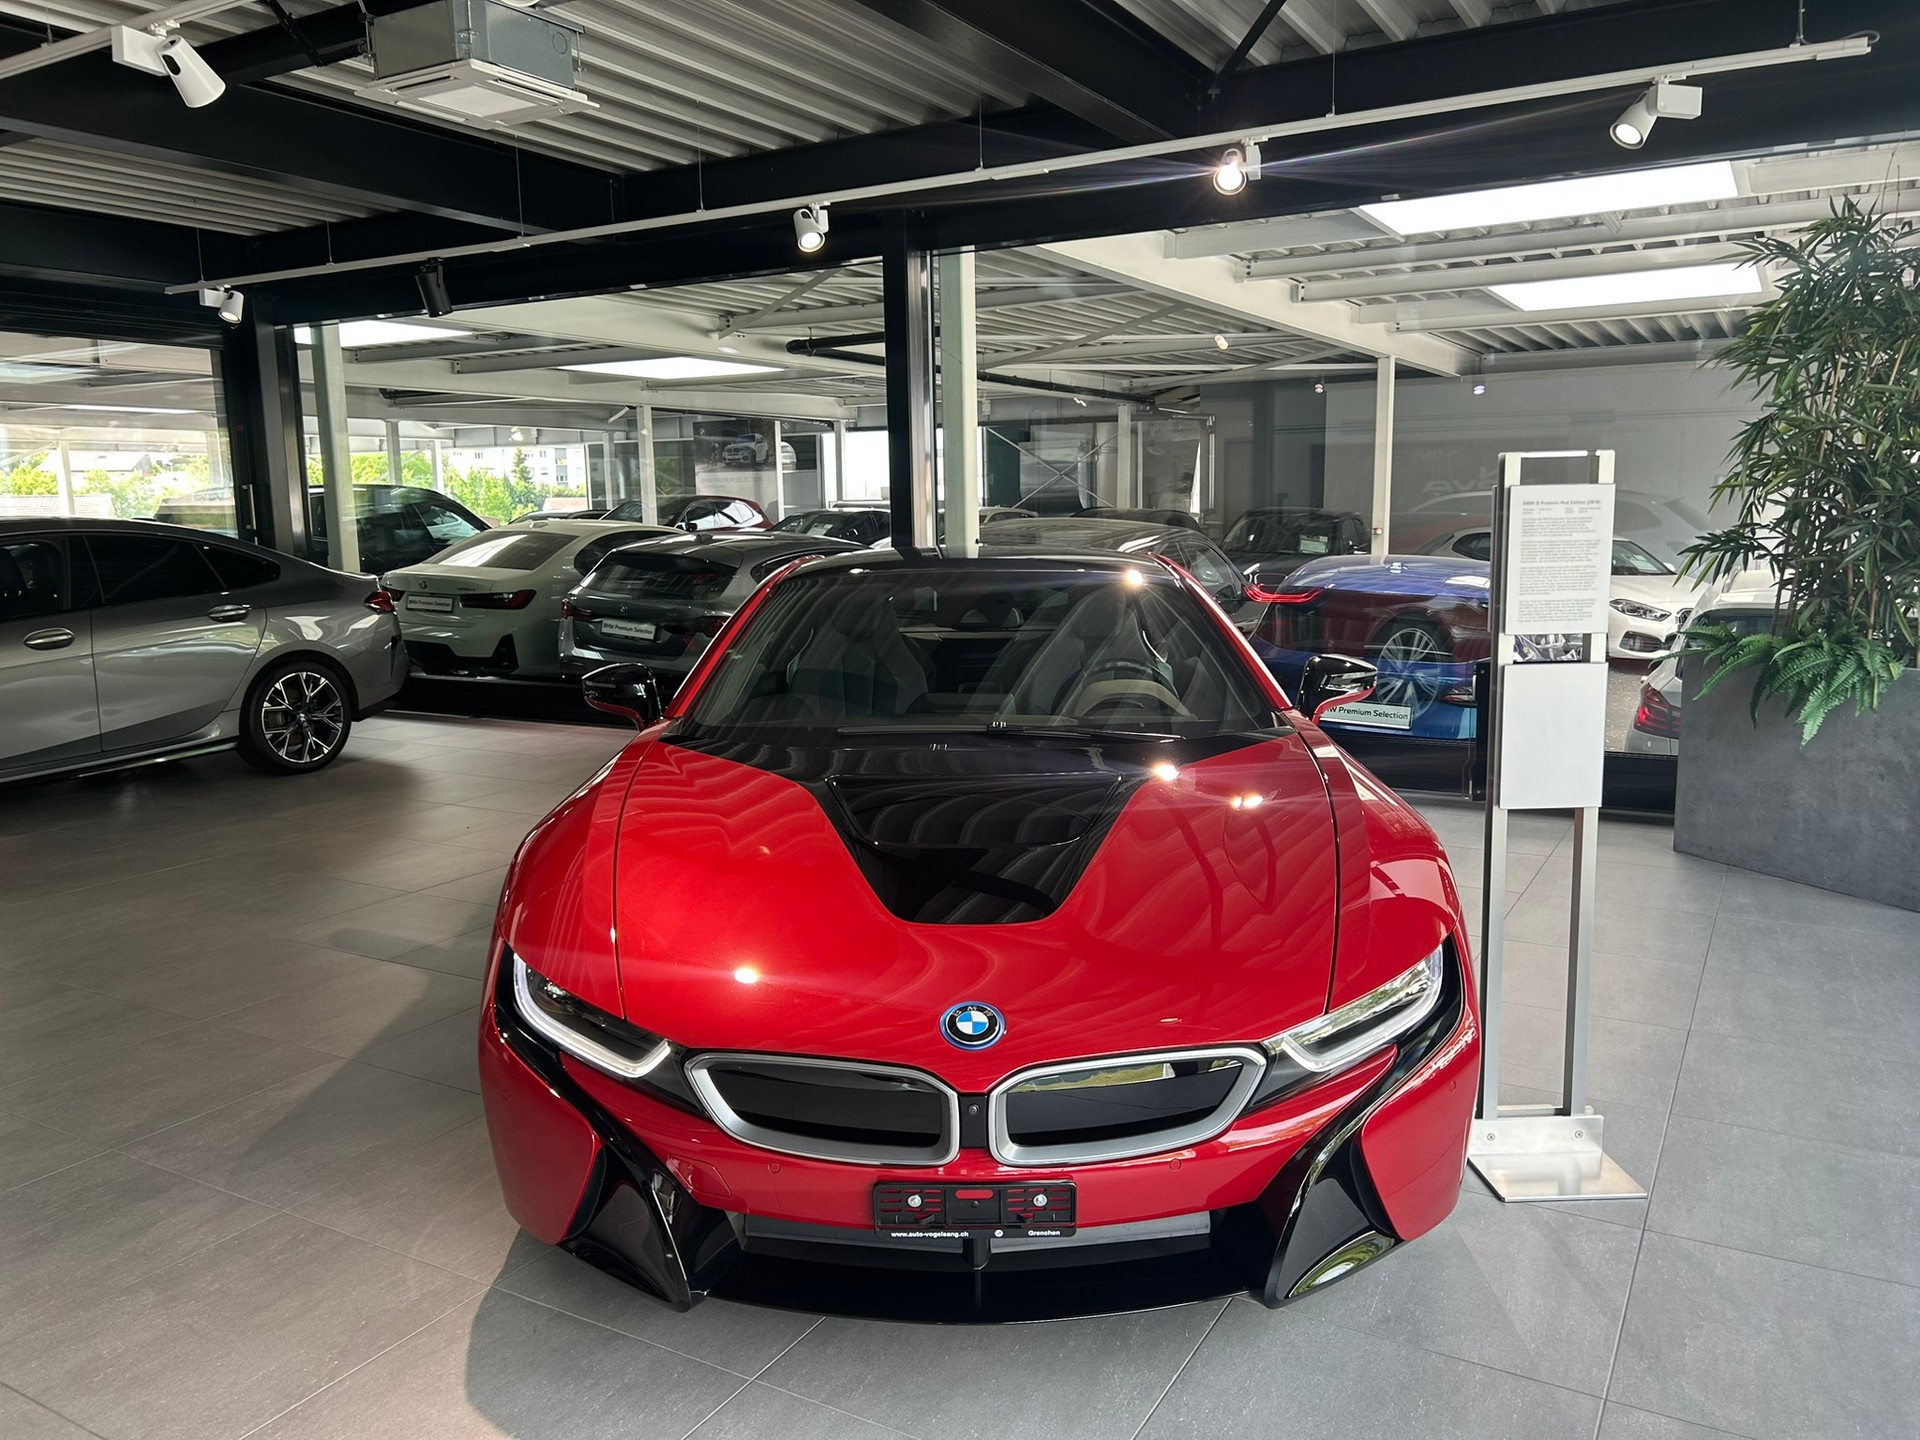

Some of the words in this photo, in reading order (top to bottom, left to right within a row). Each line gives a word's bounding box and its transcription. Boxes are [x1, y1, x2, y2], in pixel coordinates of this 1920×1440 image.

[603, 622, 614, 630] BMW
[614, 623, 633, 632] Premium
[633, 627, 653, 635] Selection
[1338, 707, 1372, 716] Premium
[1373, 710, 1408, 720] Selection
[952, 1005, 994, 1017] BMW
[890, 1231, 969, 1239] www.auto-vogelsang.ch
[1027, 1229, 1061, 1237] Grenchen
